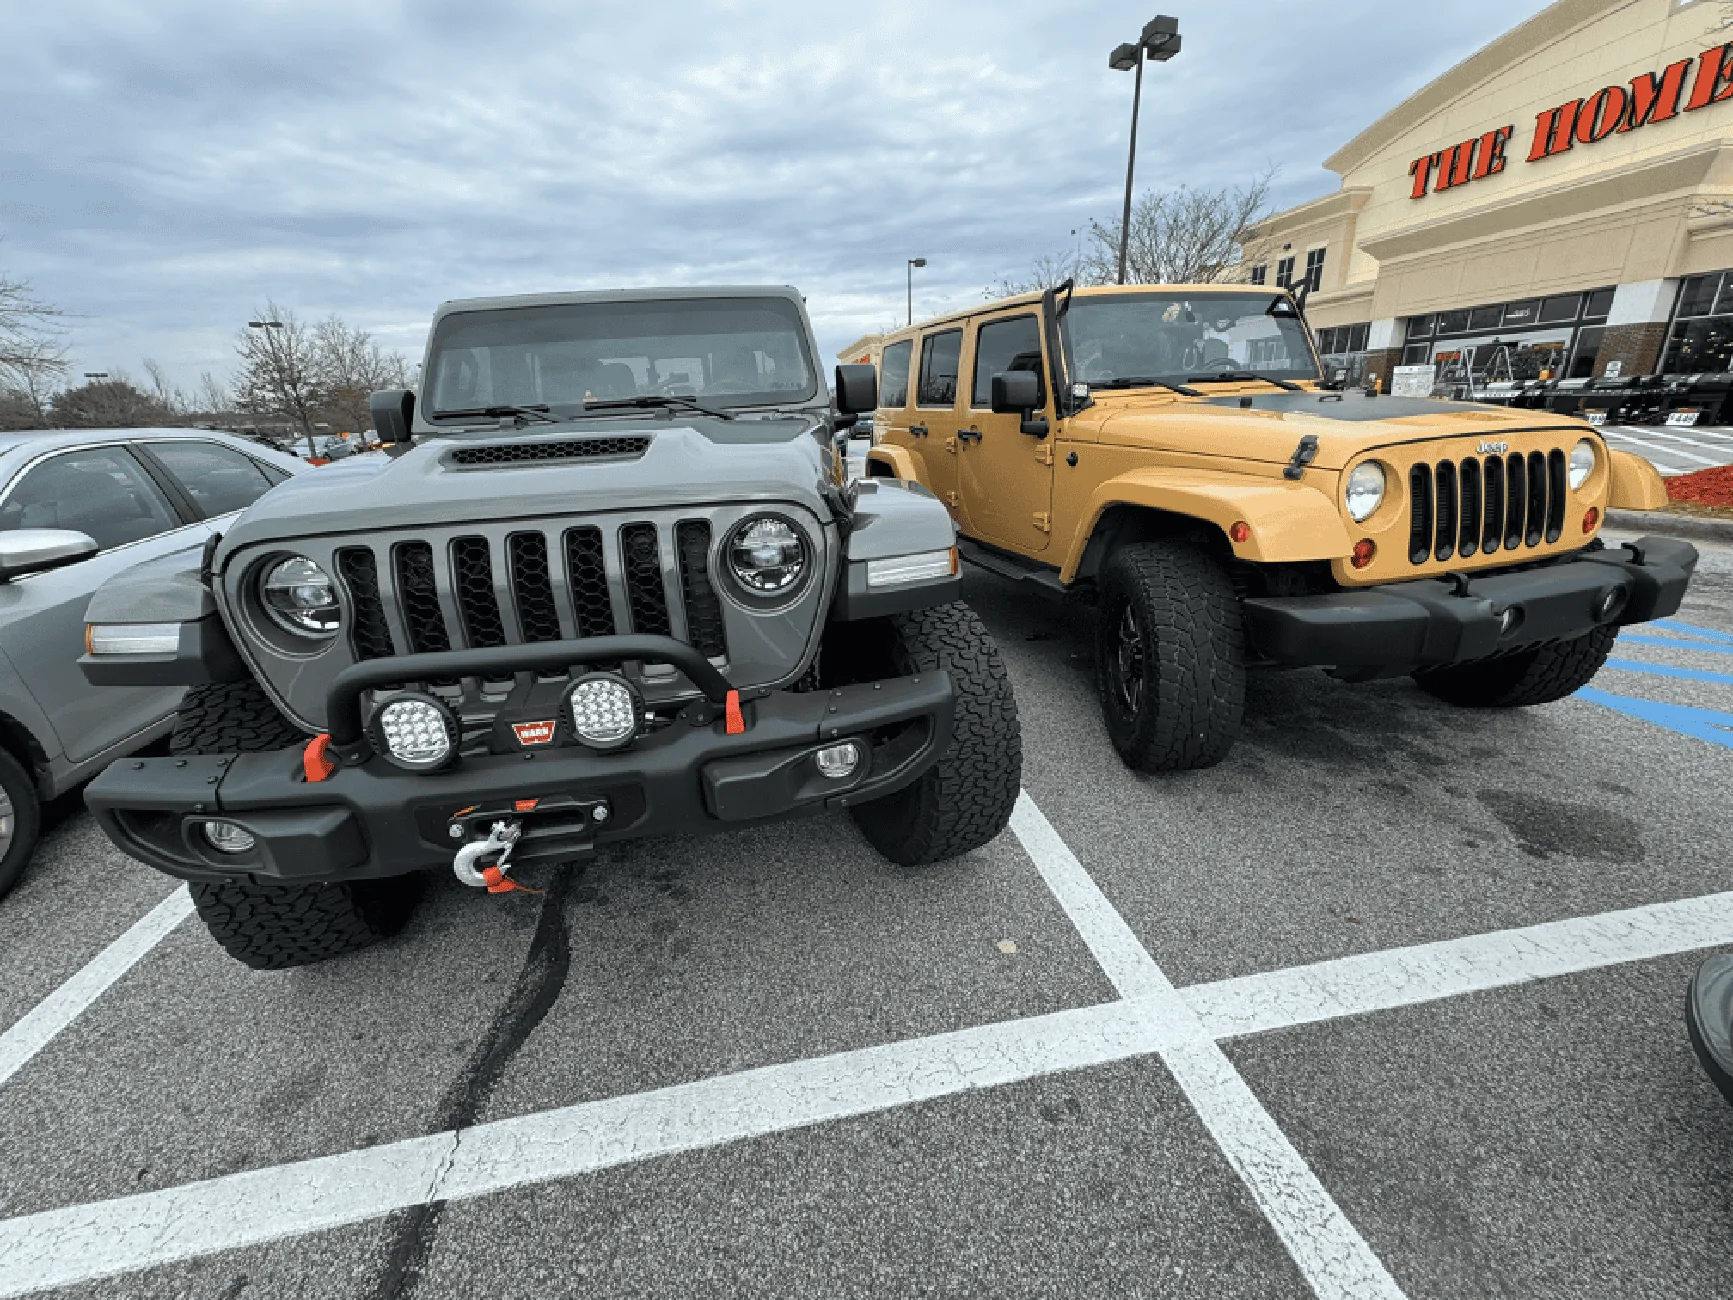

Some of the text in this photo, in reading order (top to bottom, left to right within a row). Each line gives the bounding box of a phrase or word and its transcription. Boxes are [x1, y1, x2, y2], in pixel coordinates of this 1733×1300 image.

[1408, 124, 1515, 199] THE
[1476, 439, 1508, 455] Jeep
[520, 727, 549, 738] WARN
